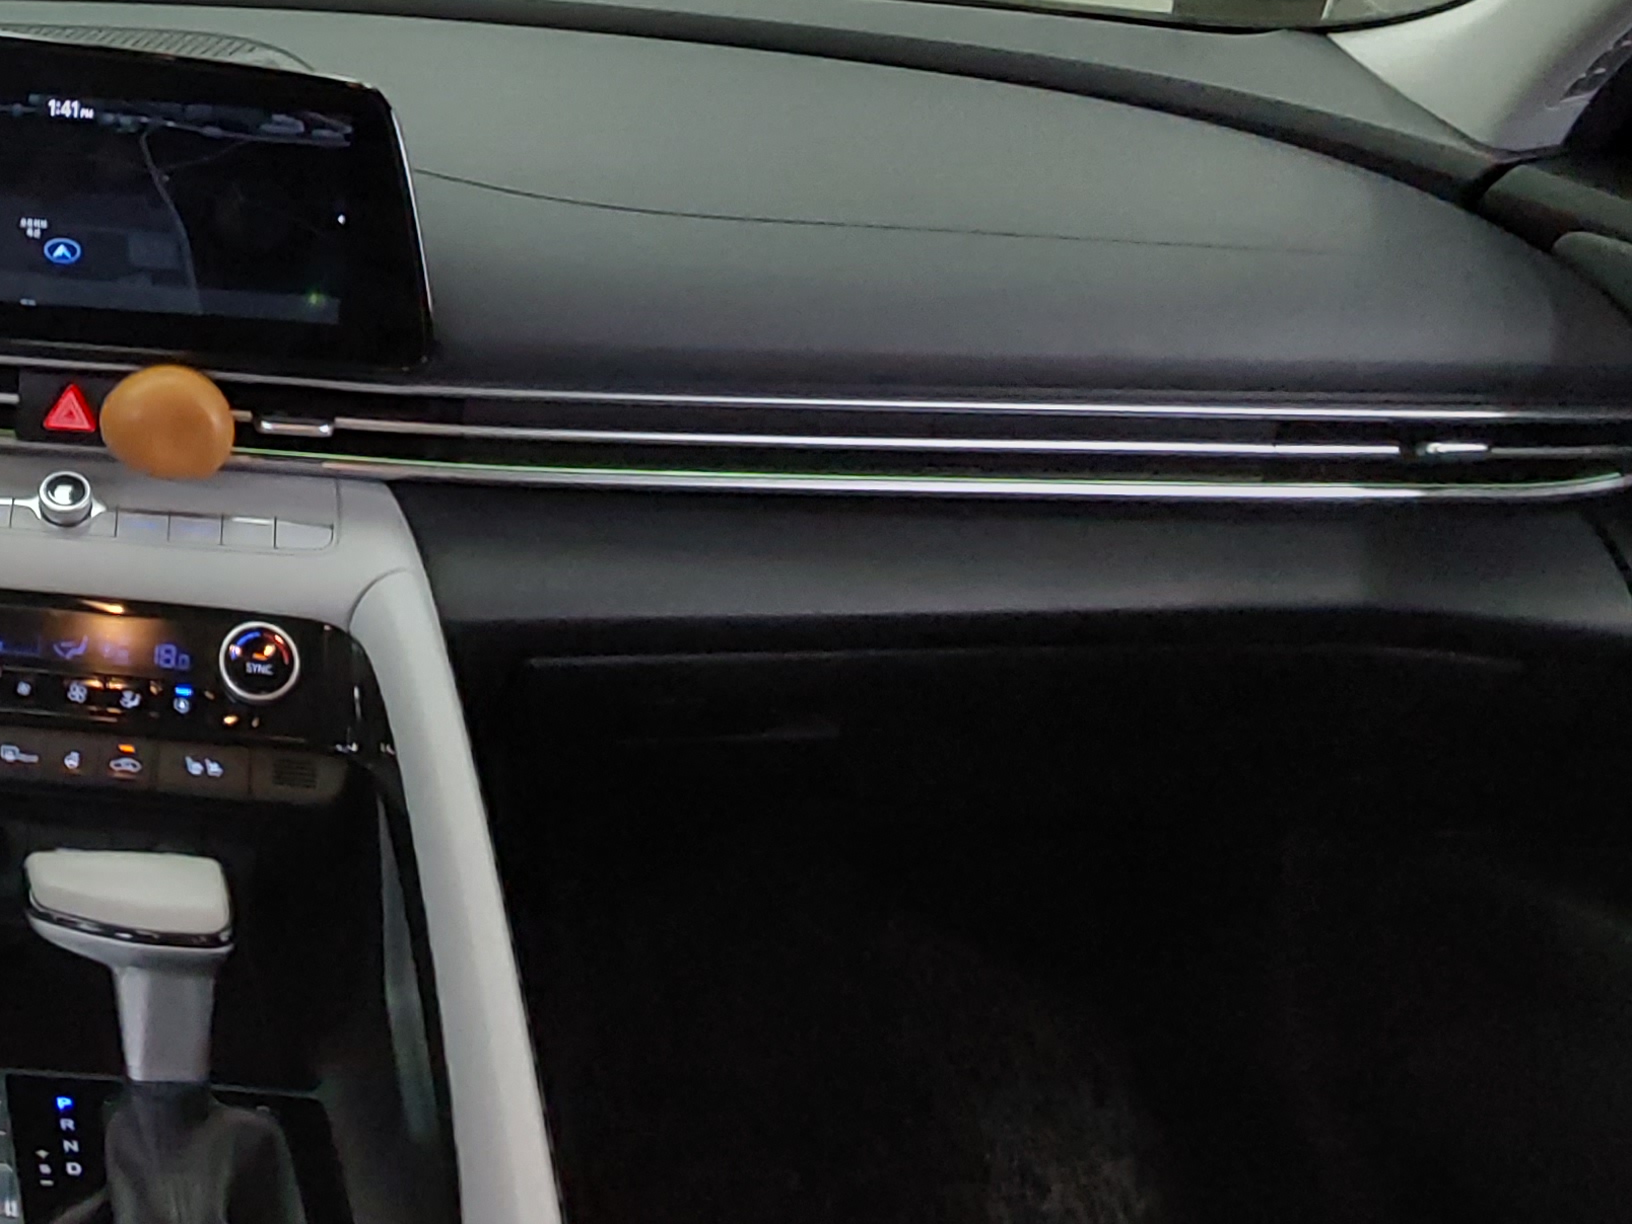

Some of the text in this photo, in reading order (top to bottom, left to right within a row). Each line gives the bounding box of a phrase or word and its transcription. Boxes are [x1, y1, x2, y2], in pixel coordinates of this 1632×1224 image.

[48, 98, 79, 118] 1:41
[246, 662, 274, 675] SYNC
[56, 1096, 74, 1110] P
[60, 1118, 76, 1131] R
[63, 1140, 80, 1153] N
[66, 1161, 83, 1176] D
